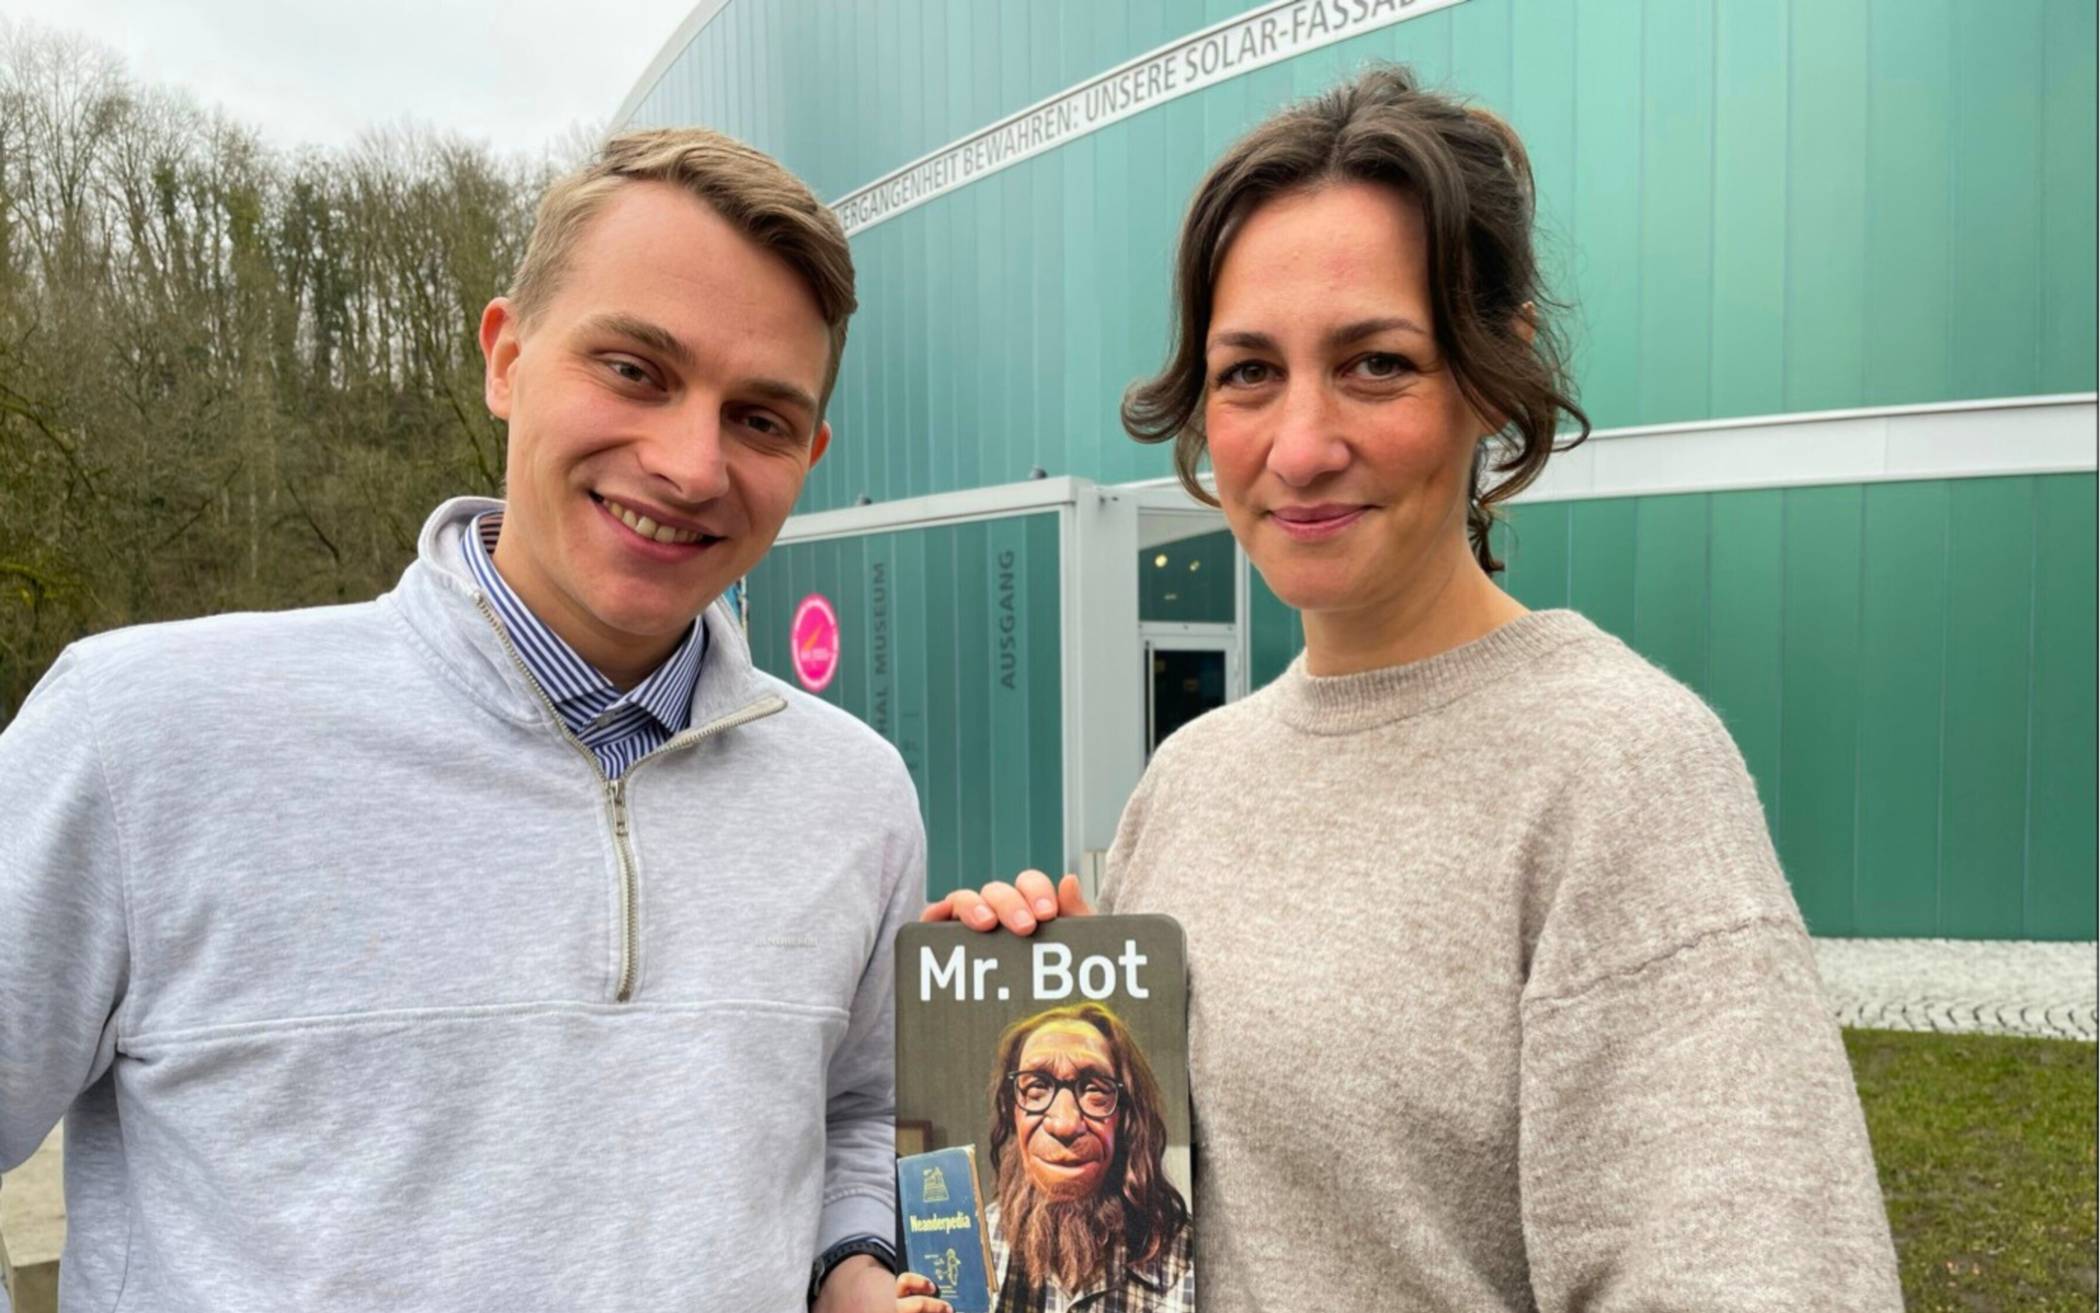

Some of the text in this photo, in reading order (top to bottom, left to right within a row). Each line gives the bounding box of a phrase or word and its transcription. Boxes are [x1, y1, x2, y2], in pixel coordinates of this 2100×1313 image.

[962, 101, 1079, 176] BEWAHREN:
[1085, 56, 1177, 122] UNSERE
[1185, 0, 1414, 82] SOLAR-FASS
[873, 562, 887, 675] MUSEUM
[998, 550, 1016, 690] AUSGANG
[919, 940, 1150, 1001] Mr. Bot
[910, 1211, 972, 1234] Neanderpedia
